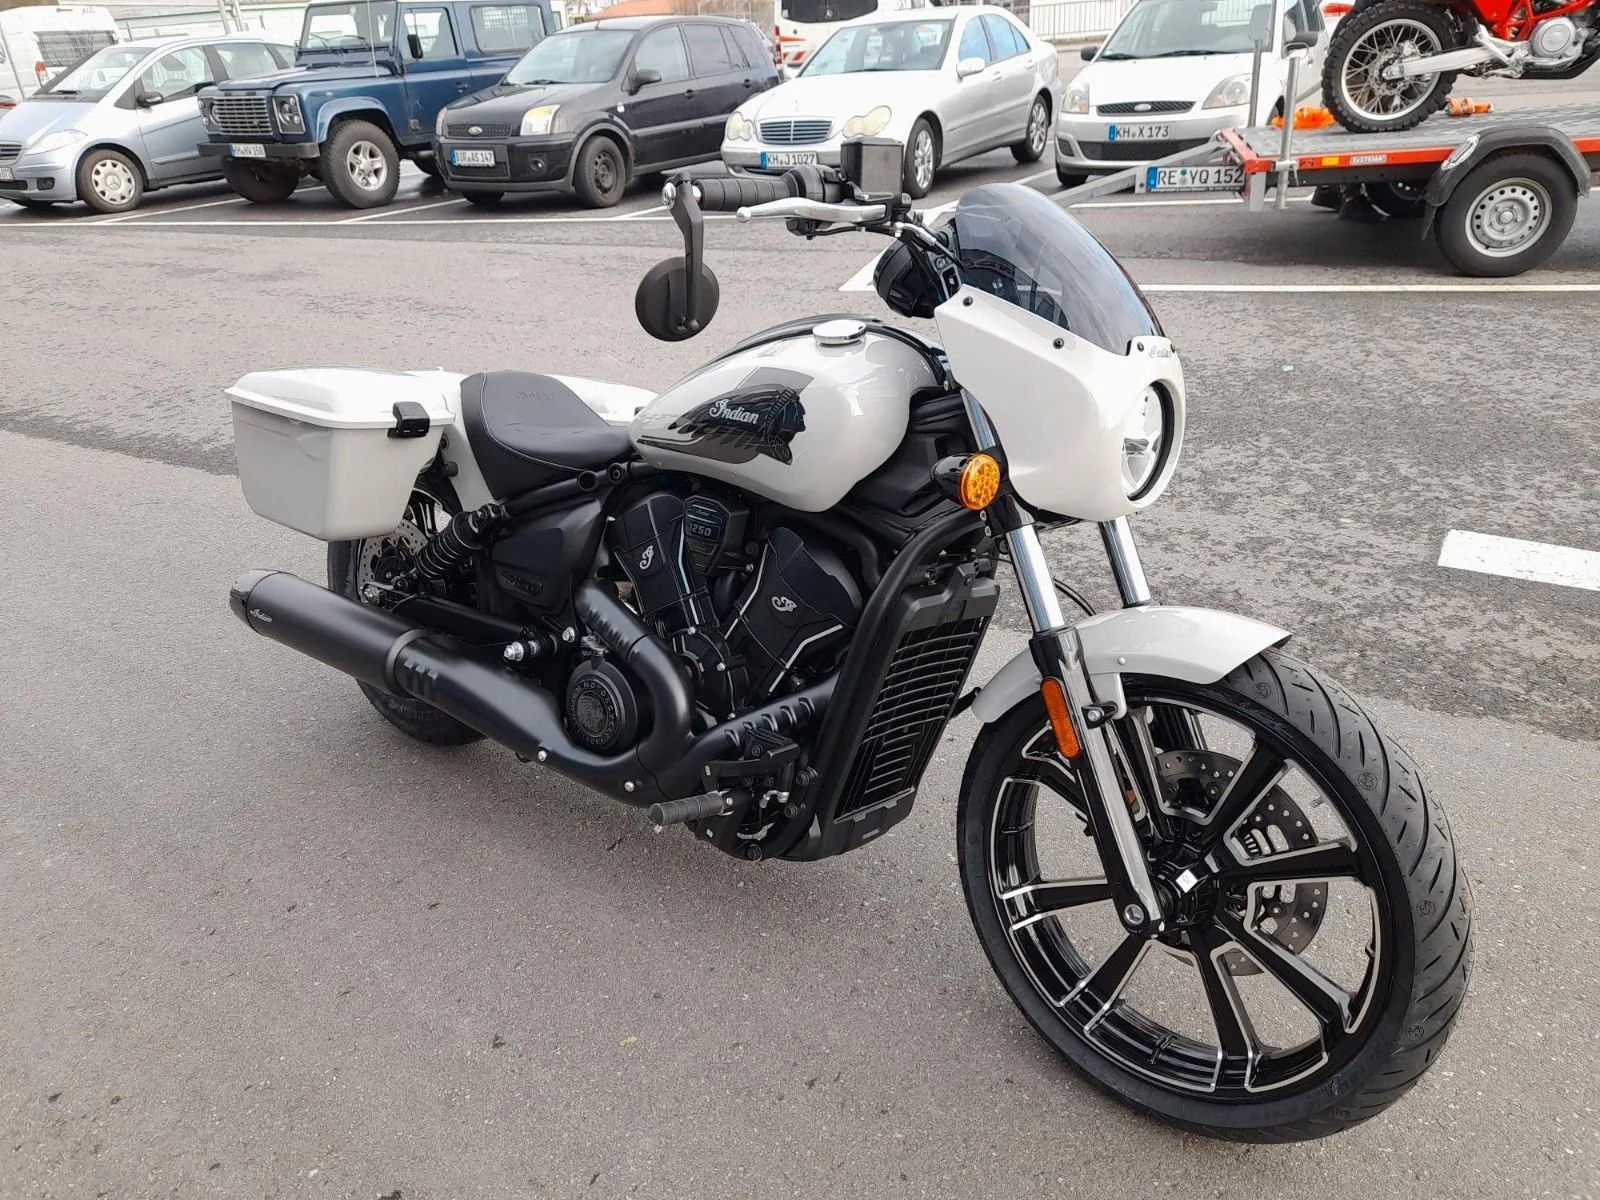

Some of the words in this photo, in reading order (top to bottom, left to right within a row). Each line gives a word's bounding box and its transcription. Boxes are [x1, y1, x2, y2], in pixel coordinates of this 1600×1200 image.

[1115, 126, 1130, 138] KH
[1138, 126, 1145, 138] X
[1147, 125, 1170, 138] 173
[480, 151, 493, 162] 147
[767, 154, 779, 165] KH
[1157, 169, 1177, 185] RE
[1189, 169, 1210, 184] YQ
[1213, 168, 1243, 184] 152
[709, 398, 760, 425] Indian
